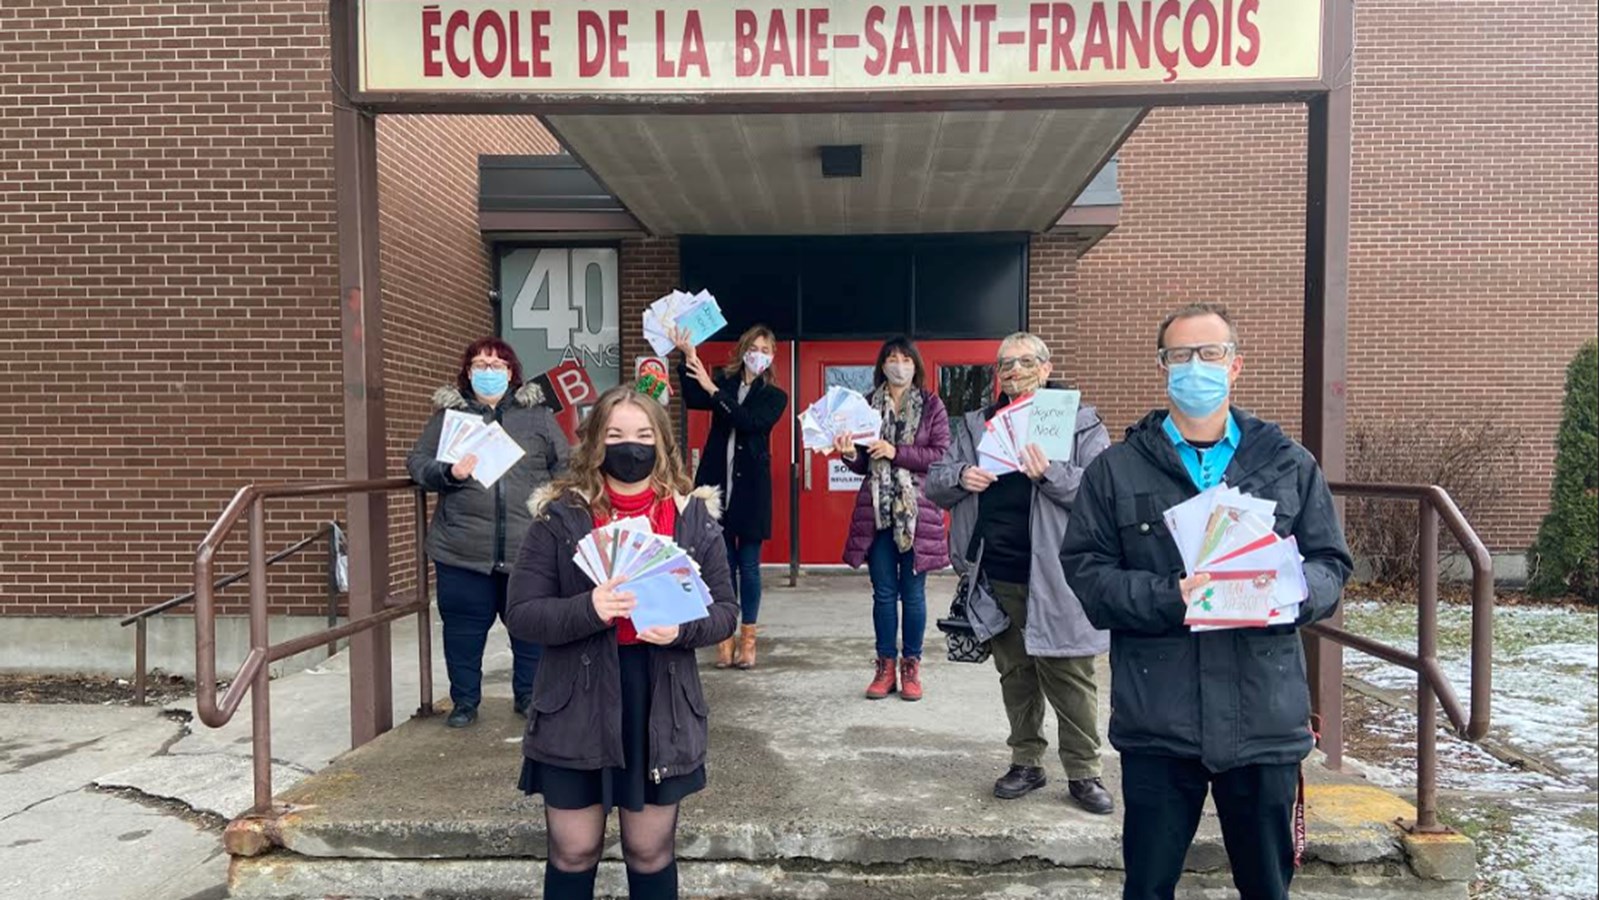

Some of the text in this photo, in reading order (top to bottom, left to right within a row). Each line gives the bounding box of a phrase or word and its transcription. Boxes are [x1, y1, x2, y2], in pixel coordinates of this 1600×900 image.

[422, 0, 1260, 82] ÉCOLE DE LA BAIE-SAINT-FRANÇOIS
[511, 248, 619, 352] 40
[558, 343, 619, 368] ANS
